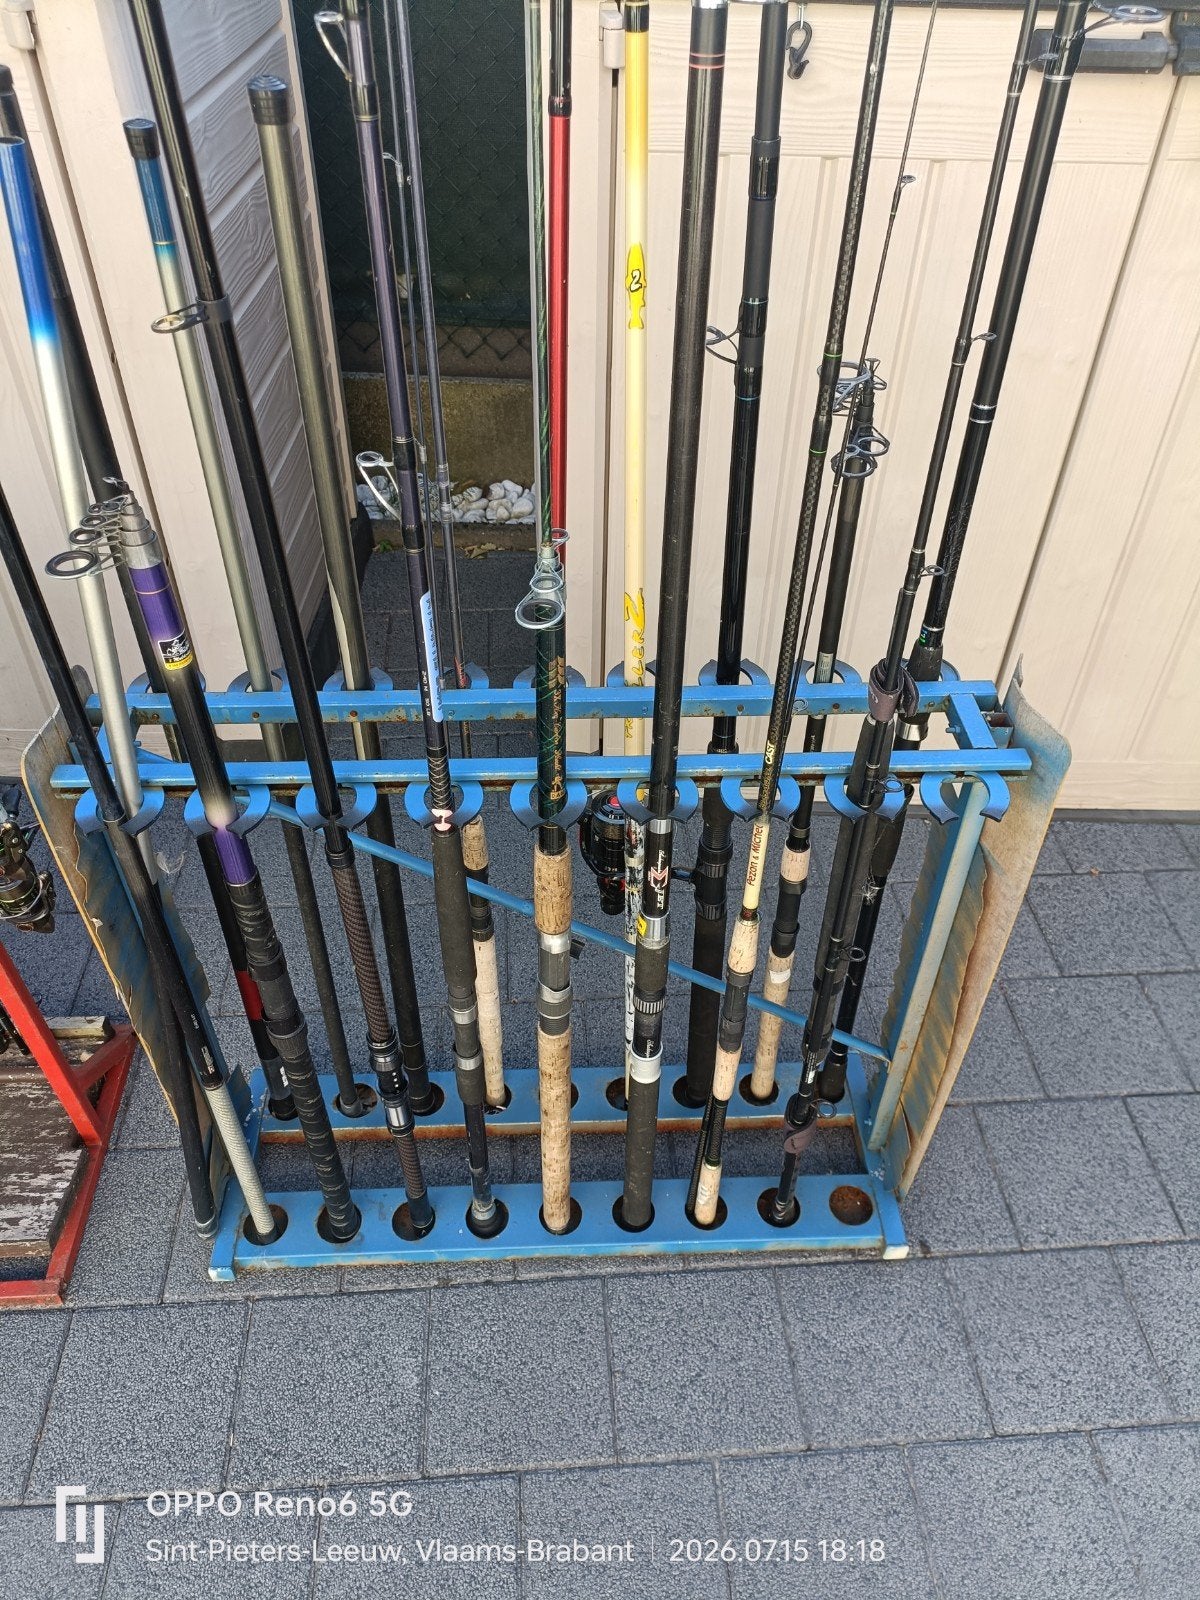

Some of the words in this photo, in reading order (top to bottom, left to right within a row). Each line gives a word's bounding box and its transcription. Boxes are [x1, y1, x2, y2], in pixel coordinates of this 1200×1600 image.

[630, 269, 642, 292] 2
[765, 740, 775, 765] CAST
[751, 823, 764, 854] Michel
[746, 861, 759, 887] Pezon
